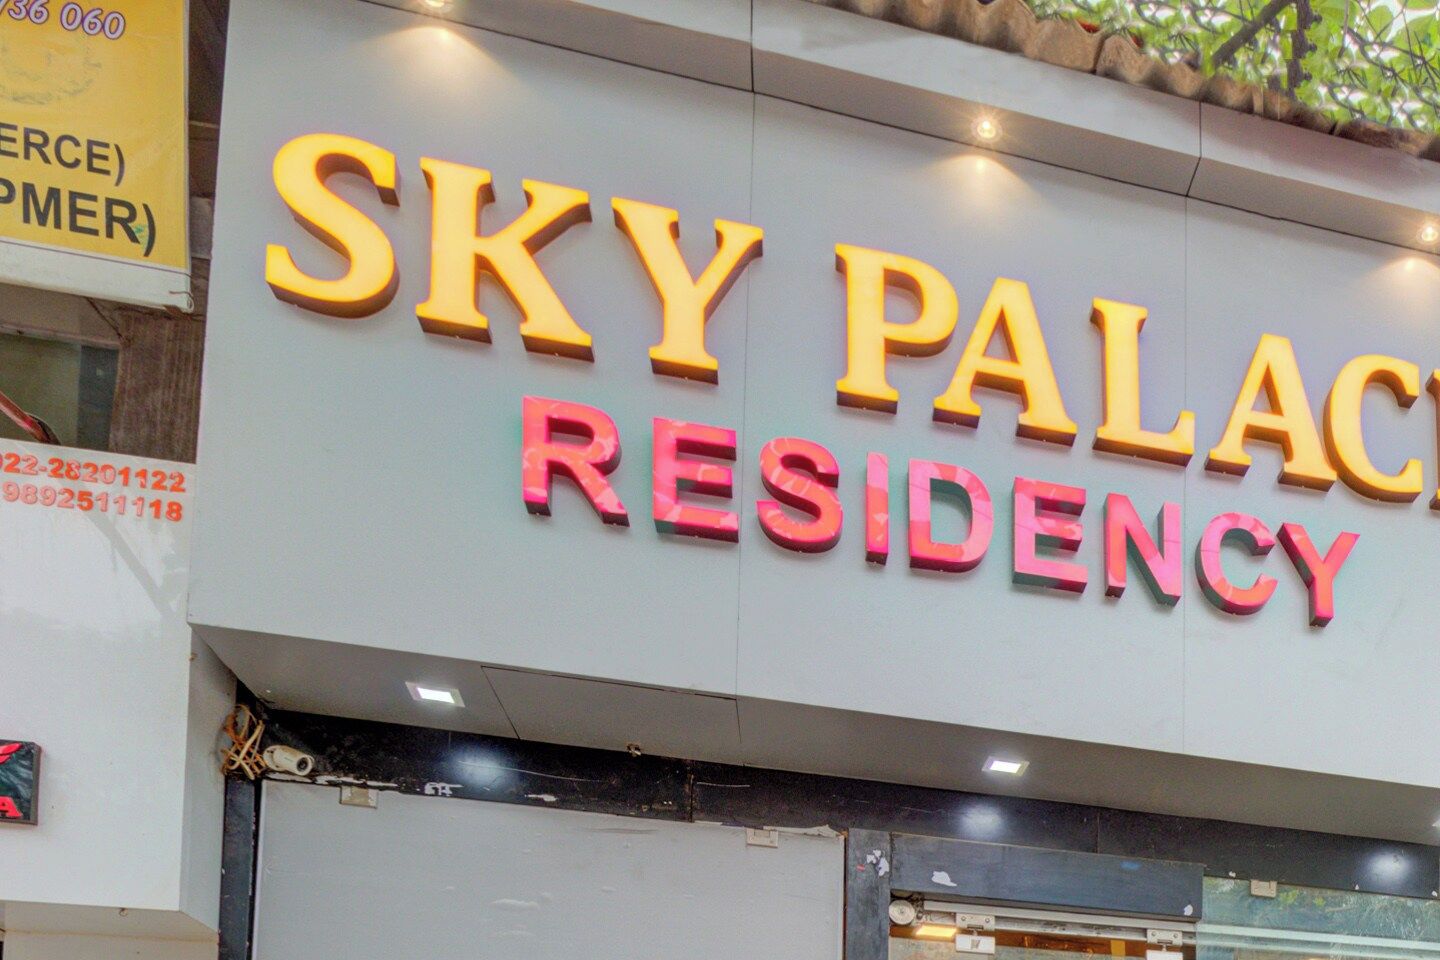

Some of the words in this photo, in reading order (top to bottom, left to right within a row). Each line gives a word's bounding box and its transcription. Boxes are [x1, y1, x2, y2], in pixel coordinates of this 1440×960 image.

[0, 0, 49, 24] 36
[60, 2, 126, 40] 060
[265, 132, 764, 386] SKY
[0, 452, 187, 493] 22-28201122
[2, 481, 183, 522] 9892511118
[522, 395, 1361, 629] RESIDENCY
